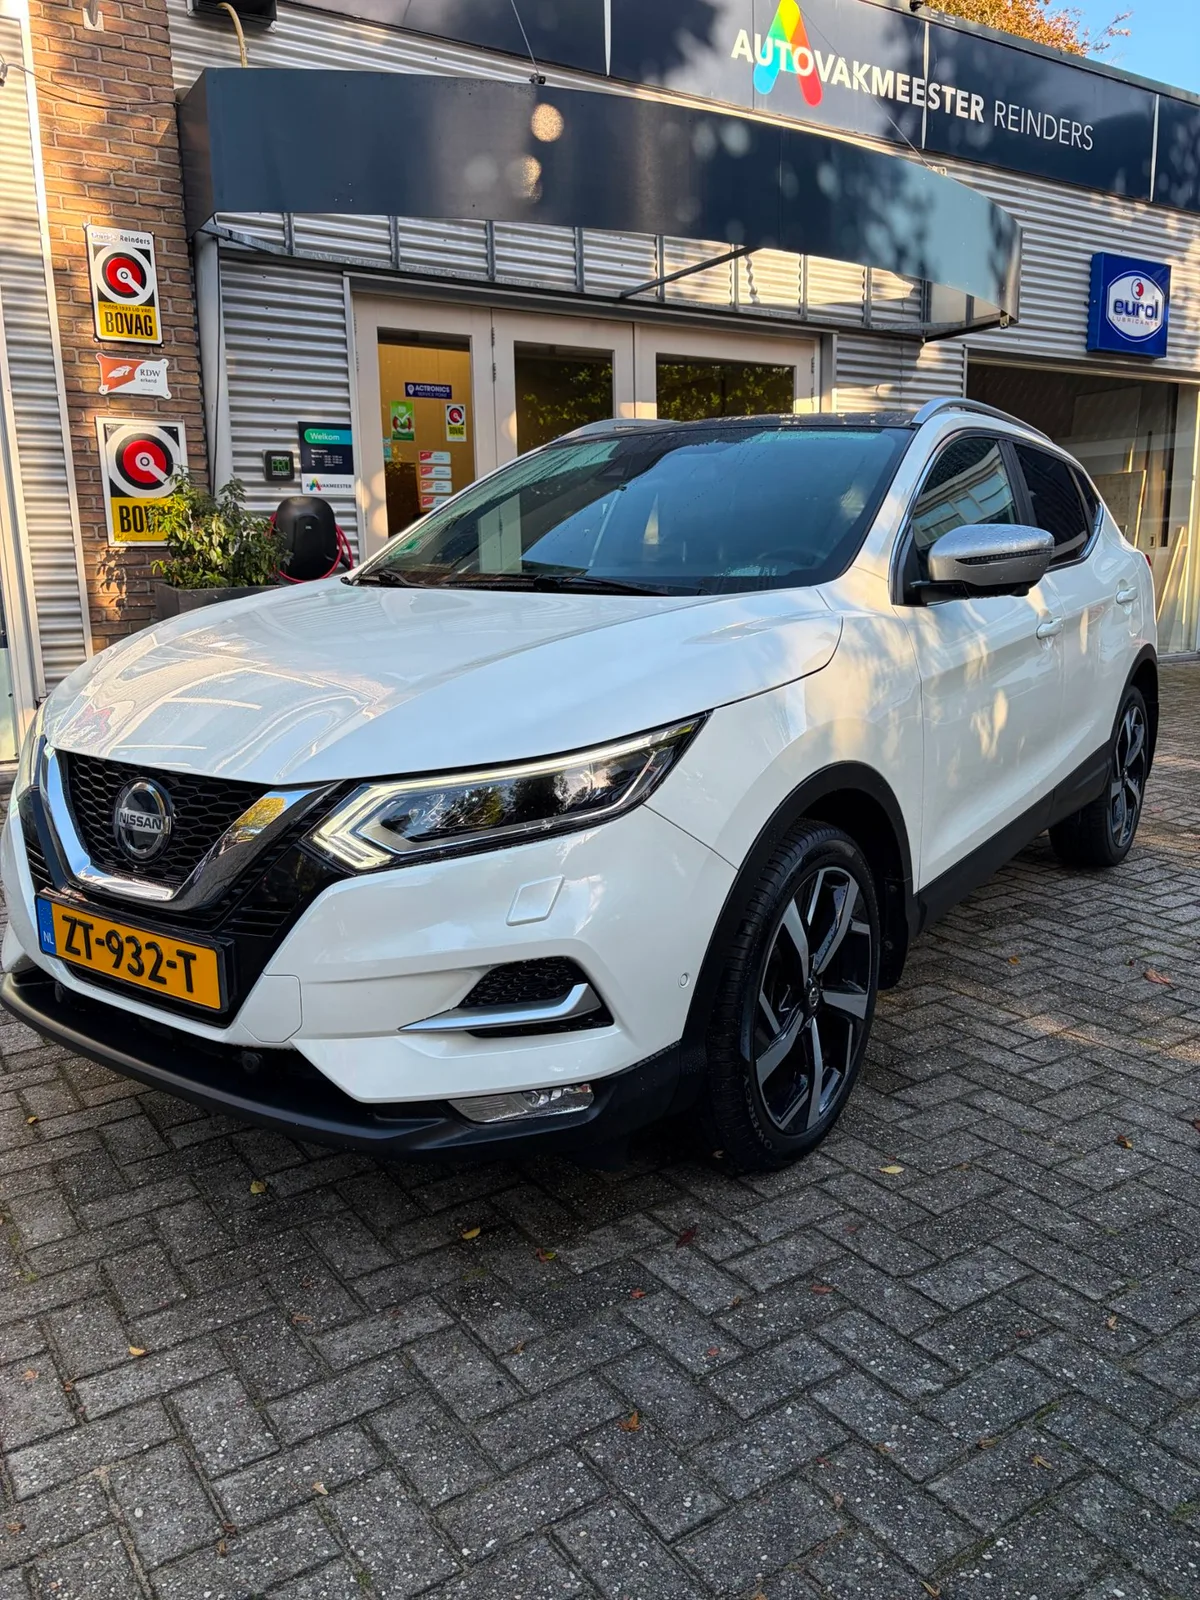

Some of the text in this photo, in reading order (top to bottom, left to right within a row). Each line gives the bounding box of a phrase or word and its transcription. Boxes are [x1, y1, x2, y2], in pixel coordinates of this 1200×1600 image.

[731, 29, 1094, 151] AUTOVAKMEESTER REINDERS
[119, 235, 151, 245] Reinders
[1113, 299, 1159, 320] eurol
[105, 311, 153, 336] BOVAG
[1112, 315, 1159, 327] LUBRICANTS
[140, 369, 161, 377] RDW
[415, 385, 450, 393] ACTRONICS
[310, 432, 340, 441] Welkom
[119, 811, 161, 830] NISSAN
[43, 930, 55, 945] NL
[62, 914, 197, 993] ZT-932-T
